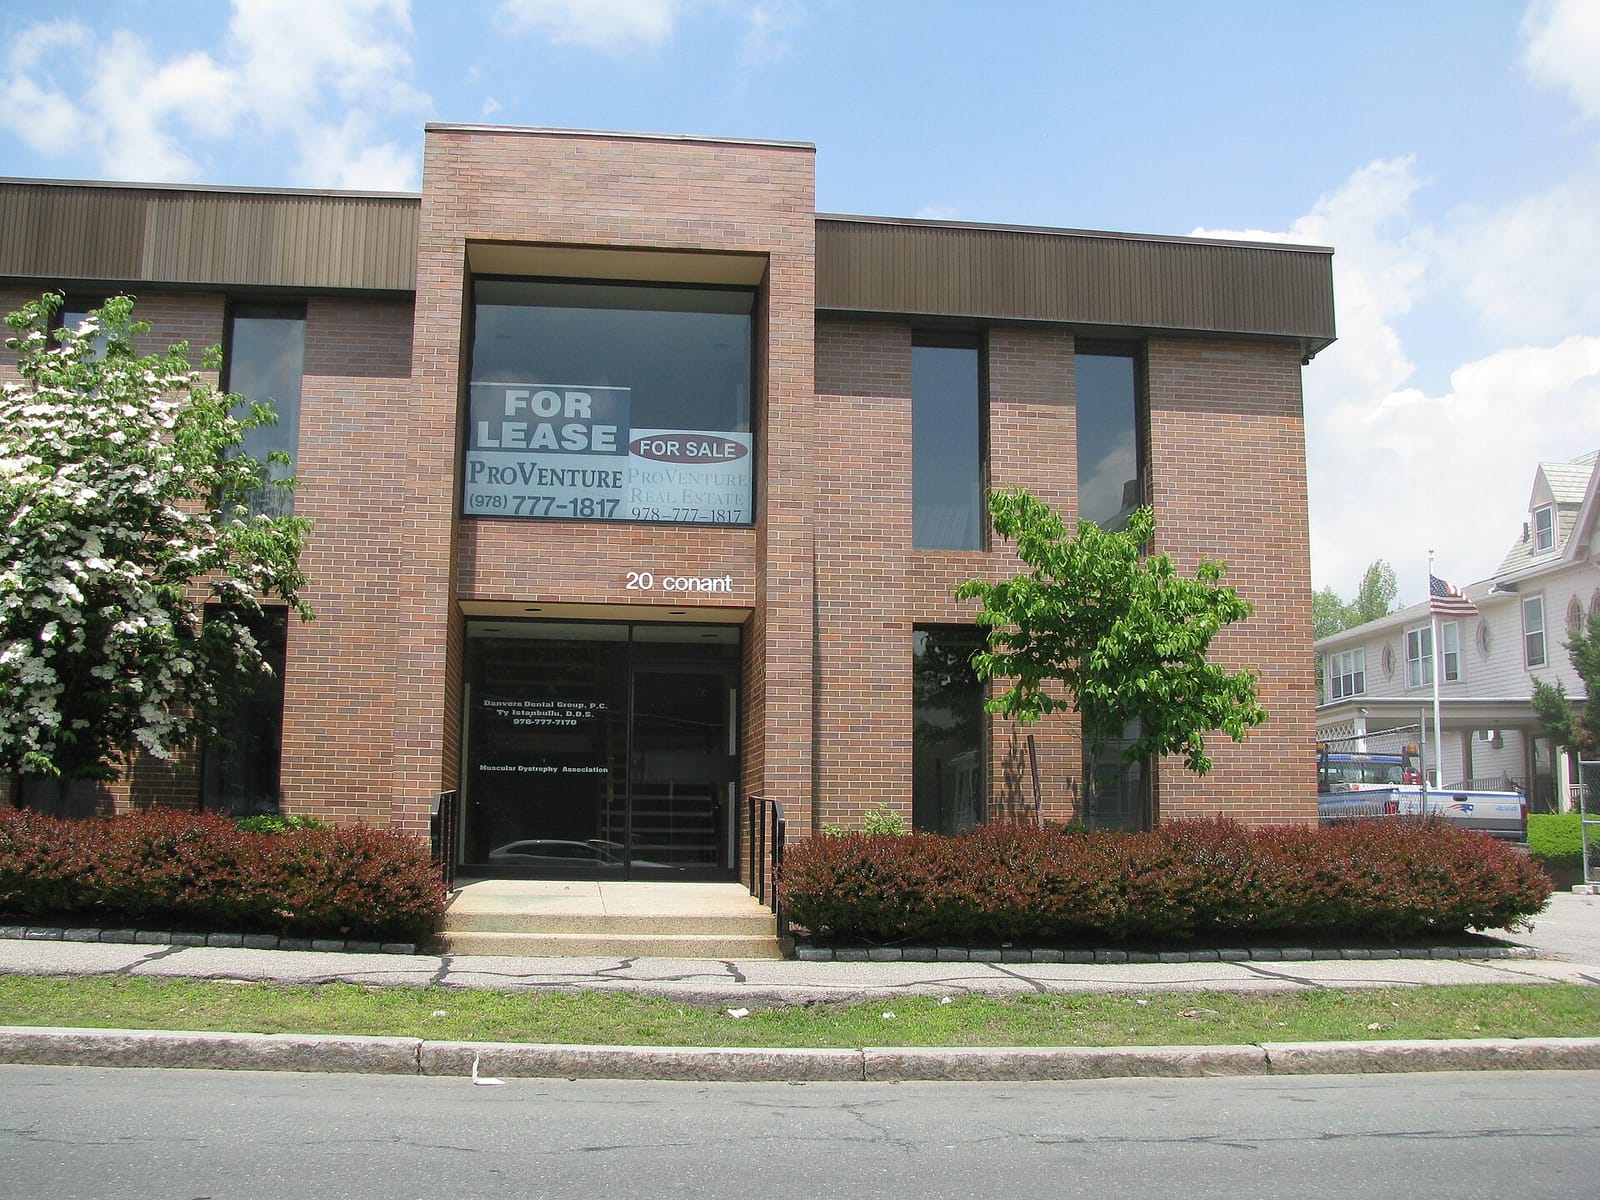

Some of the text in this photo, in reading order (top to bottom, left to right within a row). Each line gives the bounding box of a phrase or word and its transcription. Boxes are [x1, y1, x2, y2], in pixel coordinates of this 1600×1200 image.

[504, 390, 592, 418] FOR
[477, 421, 617, 452] LEASE
[640, 440, 736, 458] FOR SALE
[470, 493, 620, 518] (978) 777-1817
[631, 507, 742, 523] 978-777-1817
[625, 571, 733, 592] 20 conant
[513, 718, 577, 726] 978-777-7170
[518, 765, 558, 773] Dystrophy
